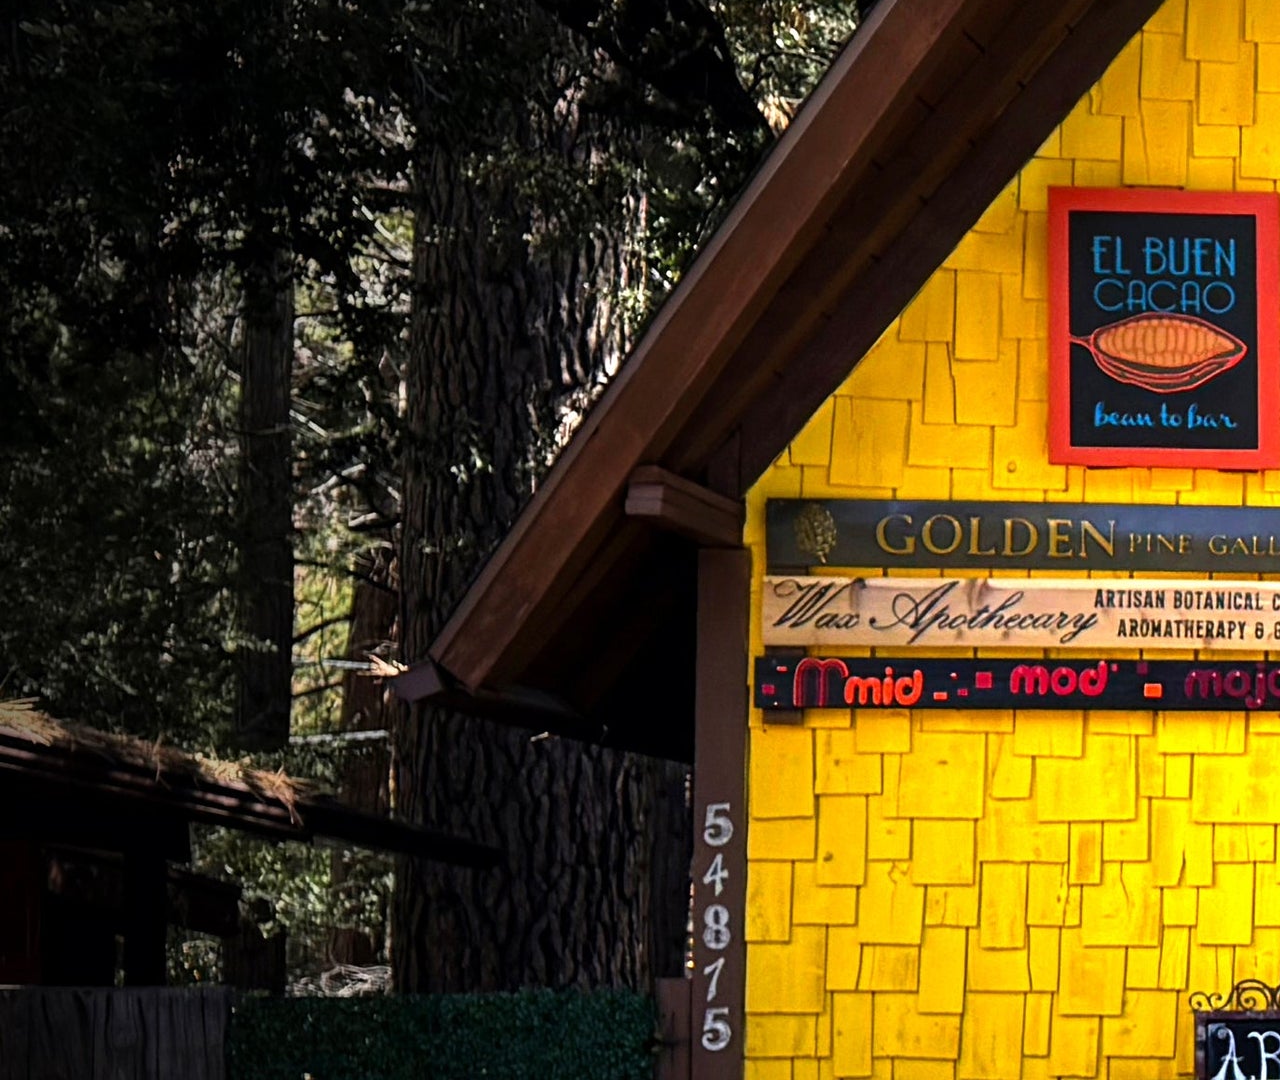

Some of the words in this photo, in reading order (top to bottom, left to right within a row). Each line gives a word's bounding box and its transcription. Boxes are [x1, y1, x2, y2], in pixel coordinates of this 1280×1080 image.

[1091, 236, 1131, 275] EL
[1142, 237, 1236, 277] BUEN
[1094, 279, 1236, 314] CACAO
[1094, 401, 1153, 428] bean
[1159, 402, 1182, 428] to
[1187, 403, 1238, 430] bar
[876, 514, 1116, 558] GOLDEN
[1129, 533, 1192, 555] PINE
[773, 577, 866, 629] Wax
[869, 580, 1098, 644] Apothecary
[1094, 589, 1165, 610] ARTISAN
[1173, 591, 1263, 612] BOTANICAL
[1117, 618, 1246, 640] AROMATHERAPY
[1010, 660, 1108, 697] mod
